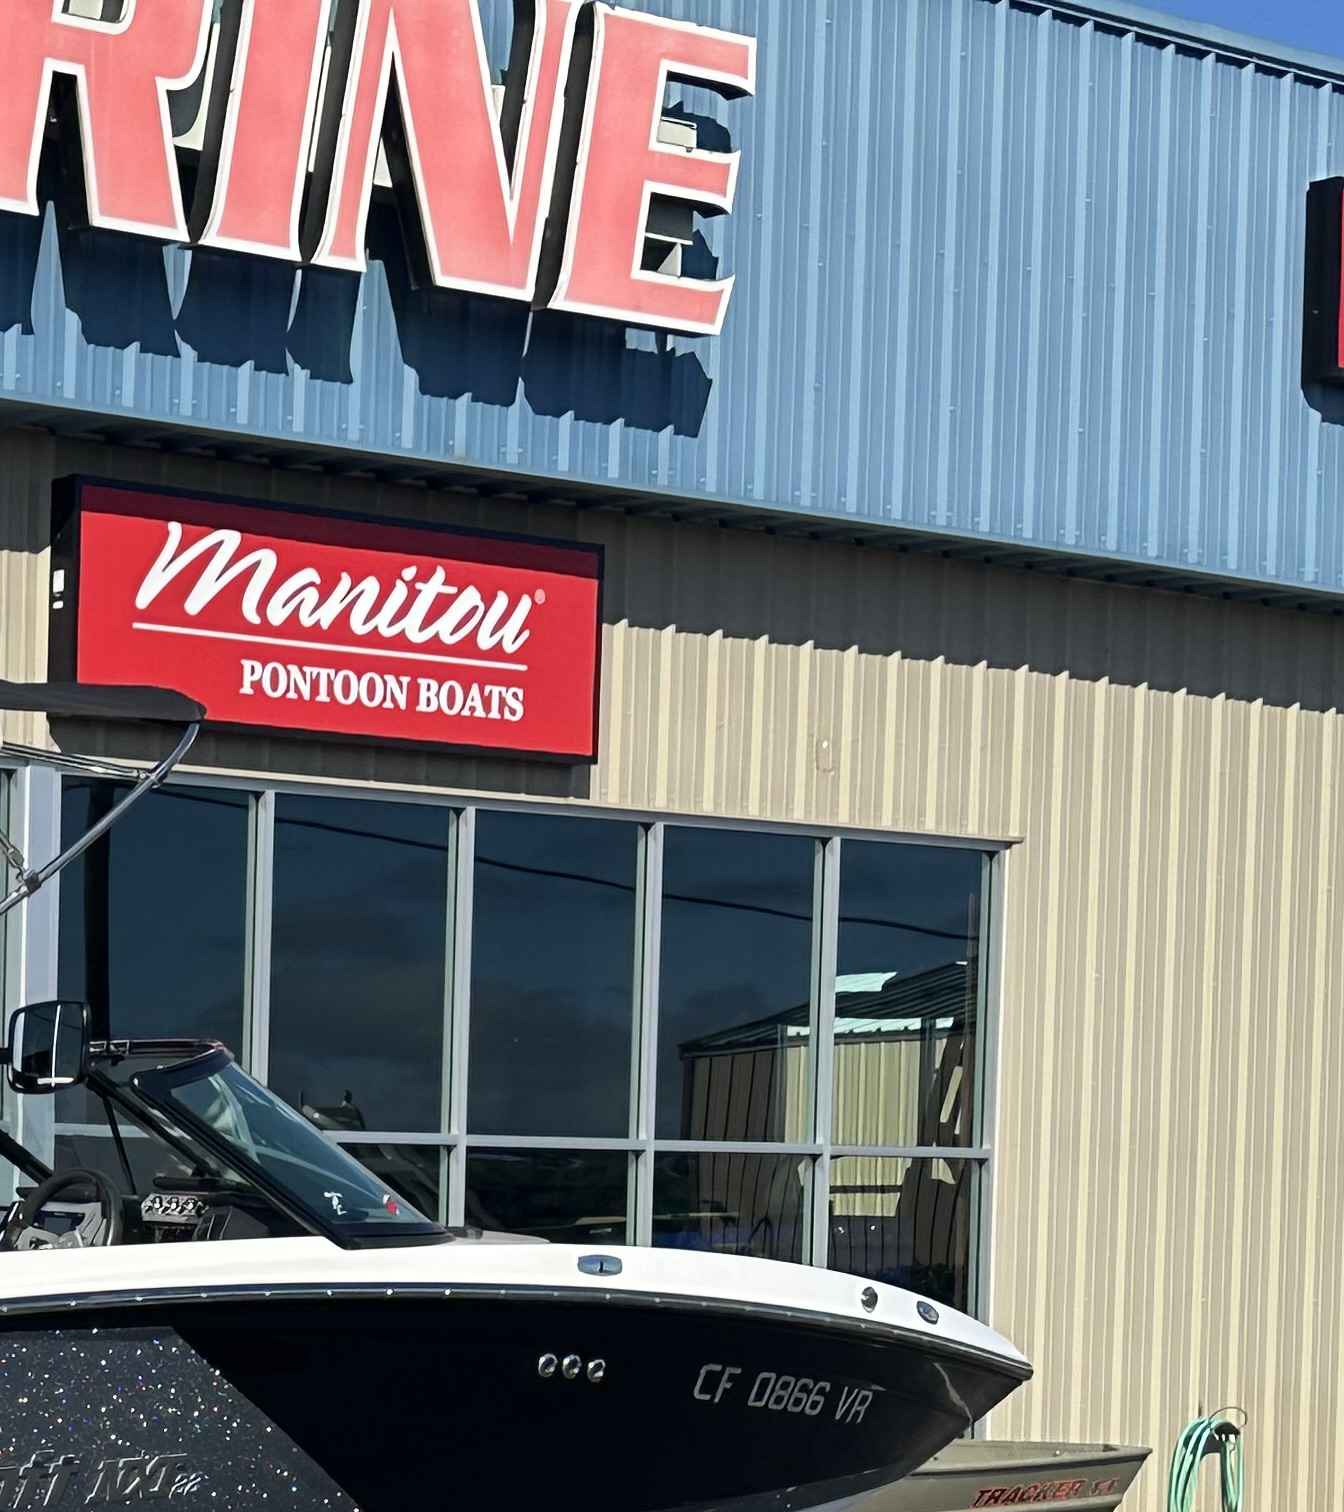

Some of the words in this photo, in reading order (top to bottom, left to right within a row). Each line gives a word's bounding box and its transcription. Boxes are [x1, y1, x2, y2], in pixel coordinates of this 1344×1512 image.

[135, 521, 531, 654] Manitou
[239, 658, 410, 710] PONTOON
[416, 677, 524, 722] BOATS
[694, 1362, 742, 1405] CF
[748, 1371, 829, 1418] 0866
[834, 1385, 874, 1425] VR
